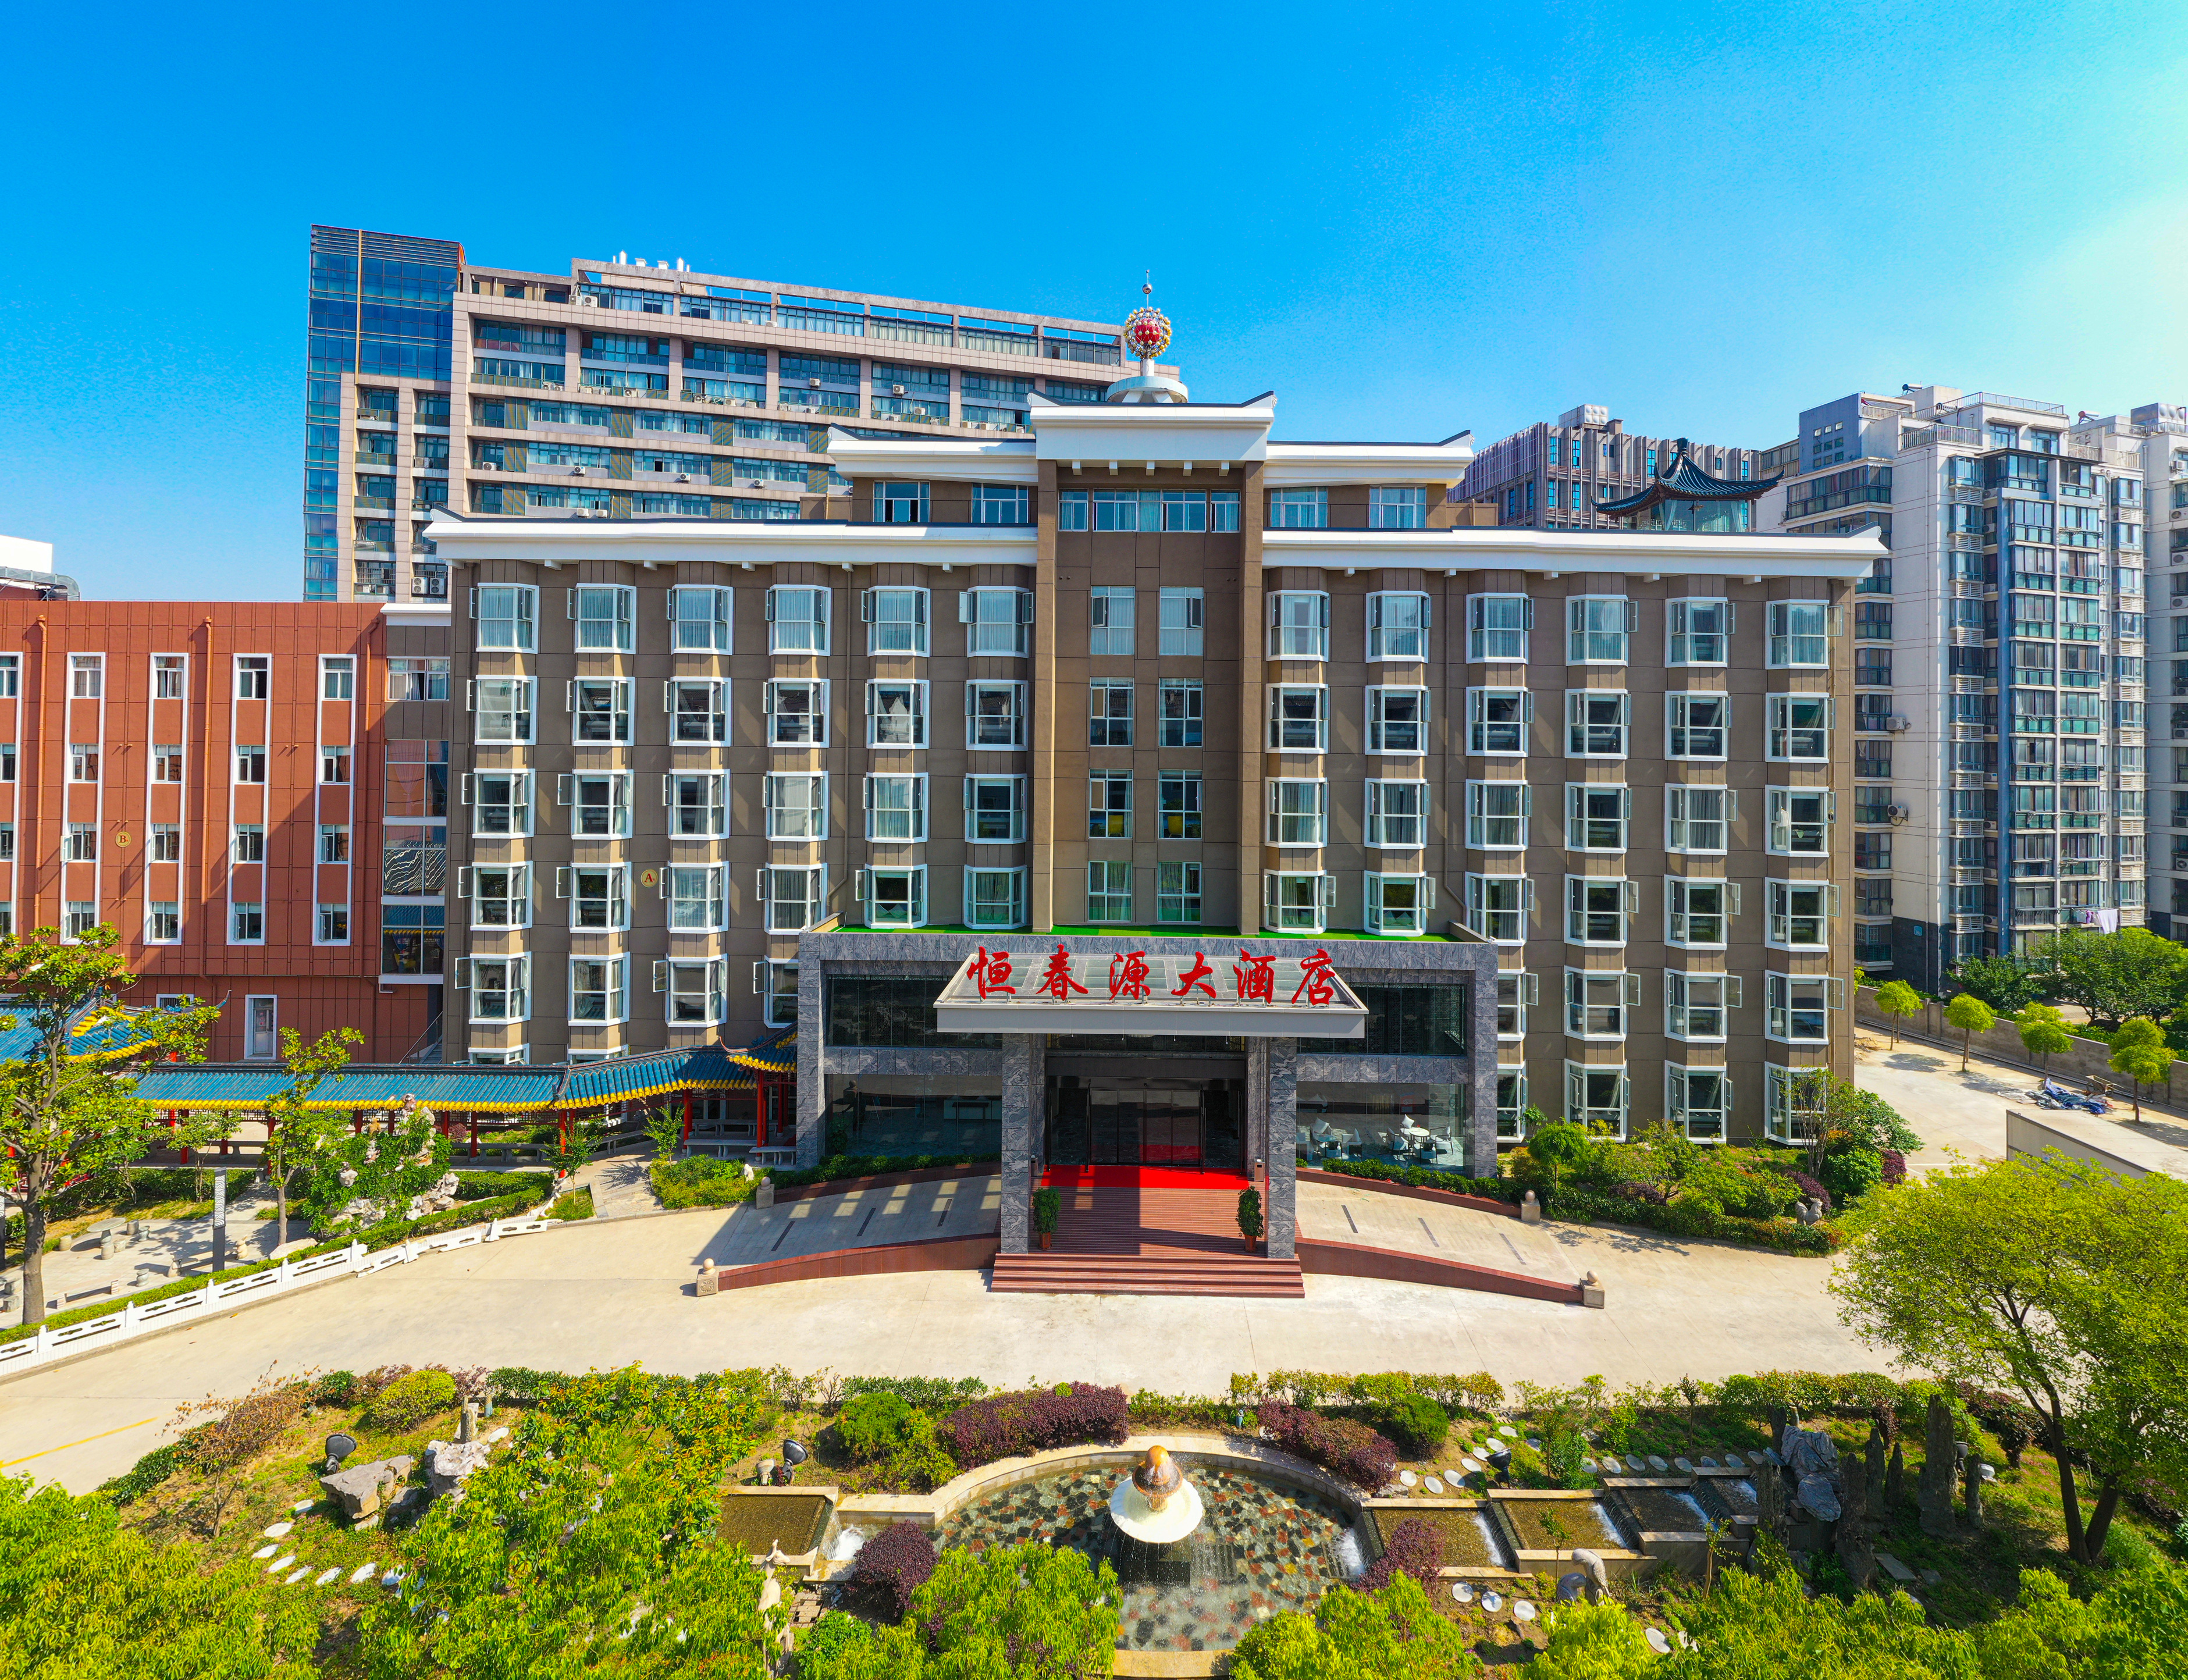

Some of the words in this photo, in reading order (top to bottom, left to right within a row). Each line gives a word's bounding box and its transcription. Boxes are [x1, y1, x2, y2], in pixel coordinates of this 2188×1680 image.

[966, 944, 1335, 1005] 恒春源大酒店
